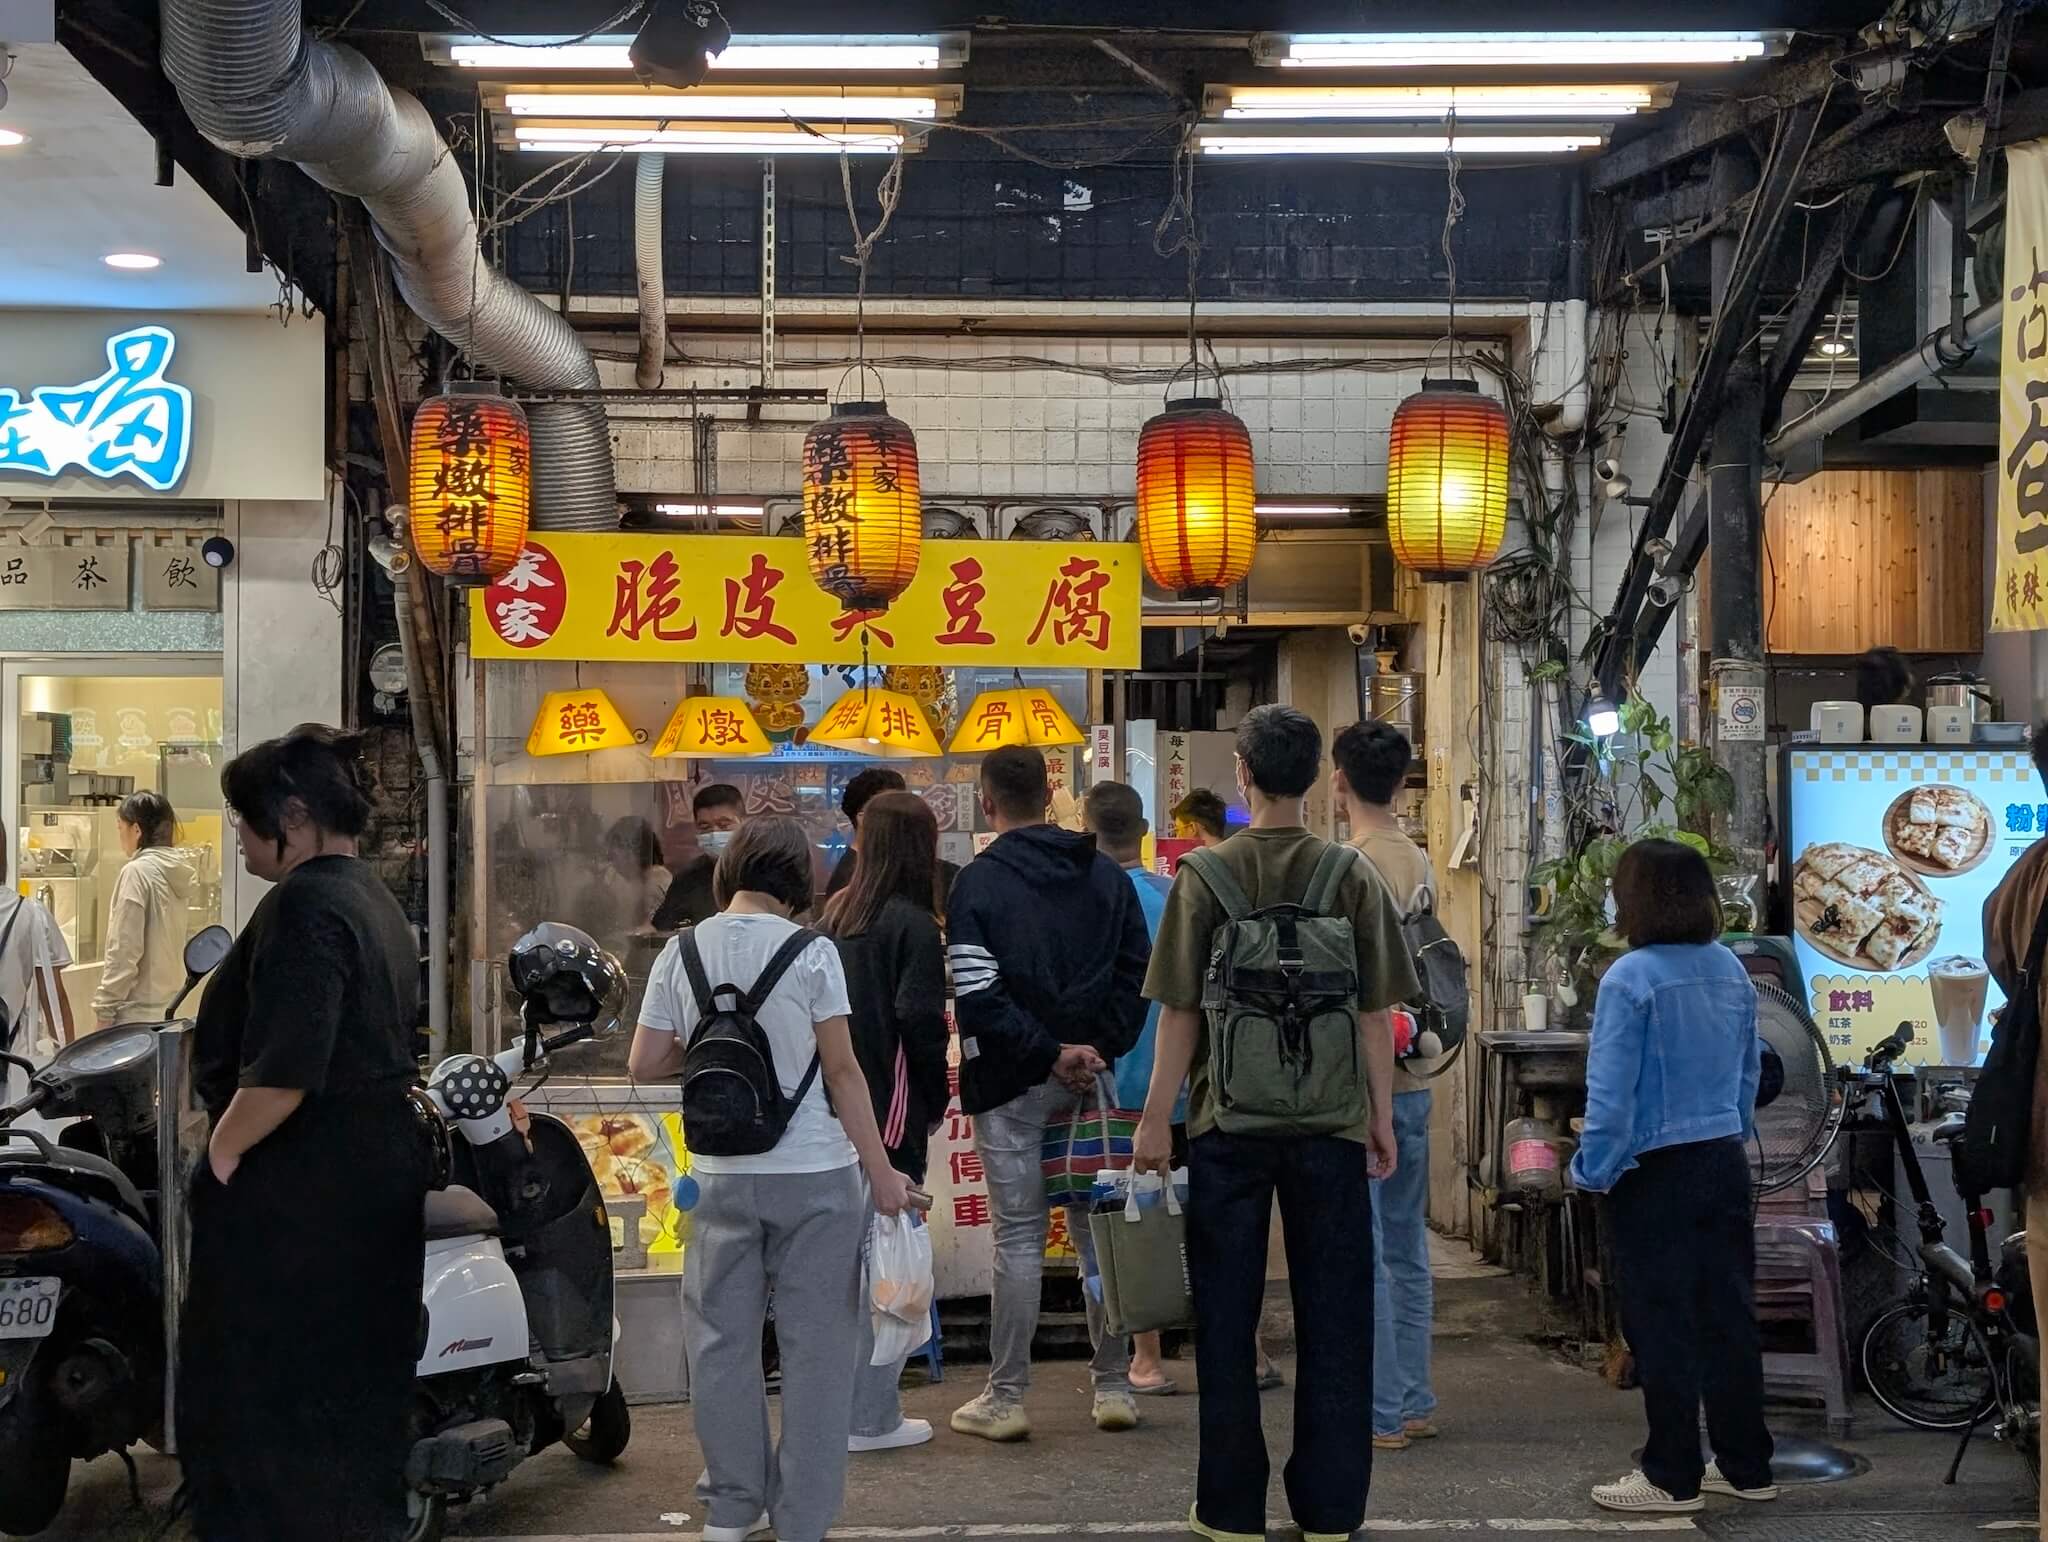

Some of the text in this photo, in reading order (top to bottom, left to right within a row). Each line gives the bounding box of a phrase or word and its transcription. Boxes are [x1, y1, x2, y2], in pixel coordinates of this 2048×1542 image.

[430, 402, 499, 572] 藥燉排骨
[803, 430, 866, 598] 藥燉排骨
[496, 550, 556, 643] 宋家
[559, 702, 607, 745] 藥
[697, 708, 749, 746] 燉
[825, 702, 863, 734] 排
[879, 701, 921, 739] 排
[975, 701, 1012, 743] 骨
[1030, 698, 1062, 737] 骨
[1097, 729, 1110, 769] 臭豆腐
[1828, 989, 1875, 1013] 飲料
[1828, 1017, 1852, 1029] 紅茶
[1828, 1034, 1852, 1046] 奶茶
